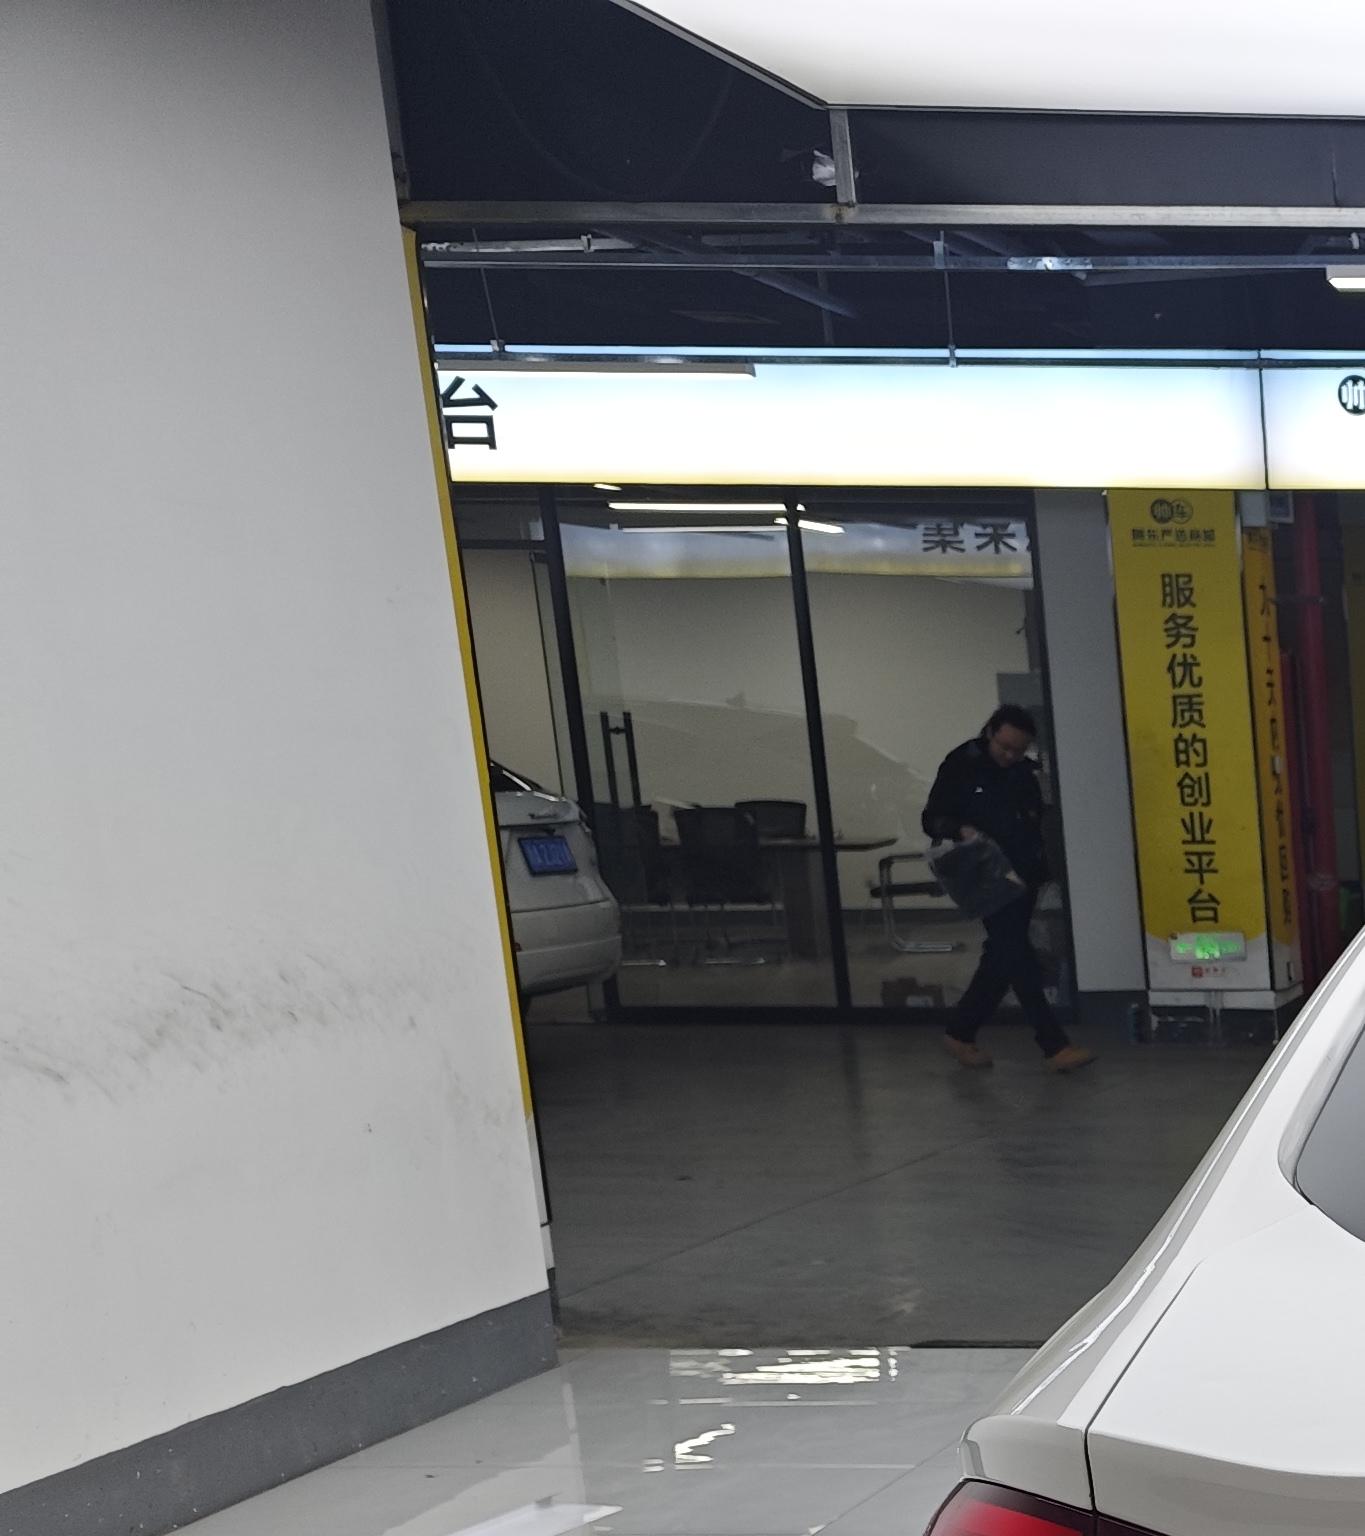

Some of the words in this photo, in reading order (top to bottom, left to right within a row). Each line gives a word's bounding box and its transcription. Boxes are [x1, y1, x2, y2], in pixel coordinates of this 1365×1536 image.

[441, 376, 498, 451] 台
[1160, 572, 1222, 924] 服务优质的创业平台
